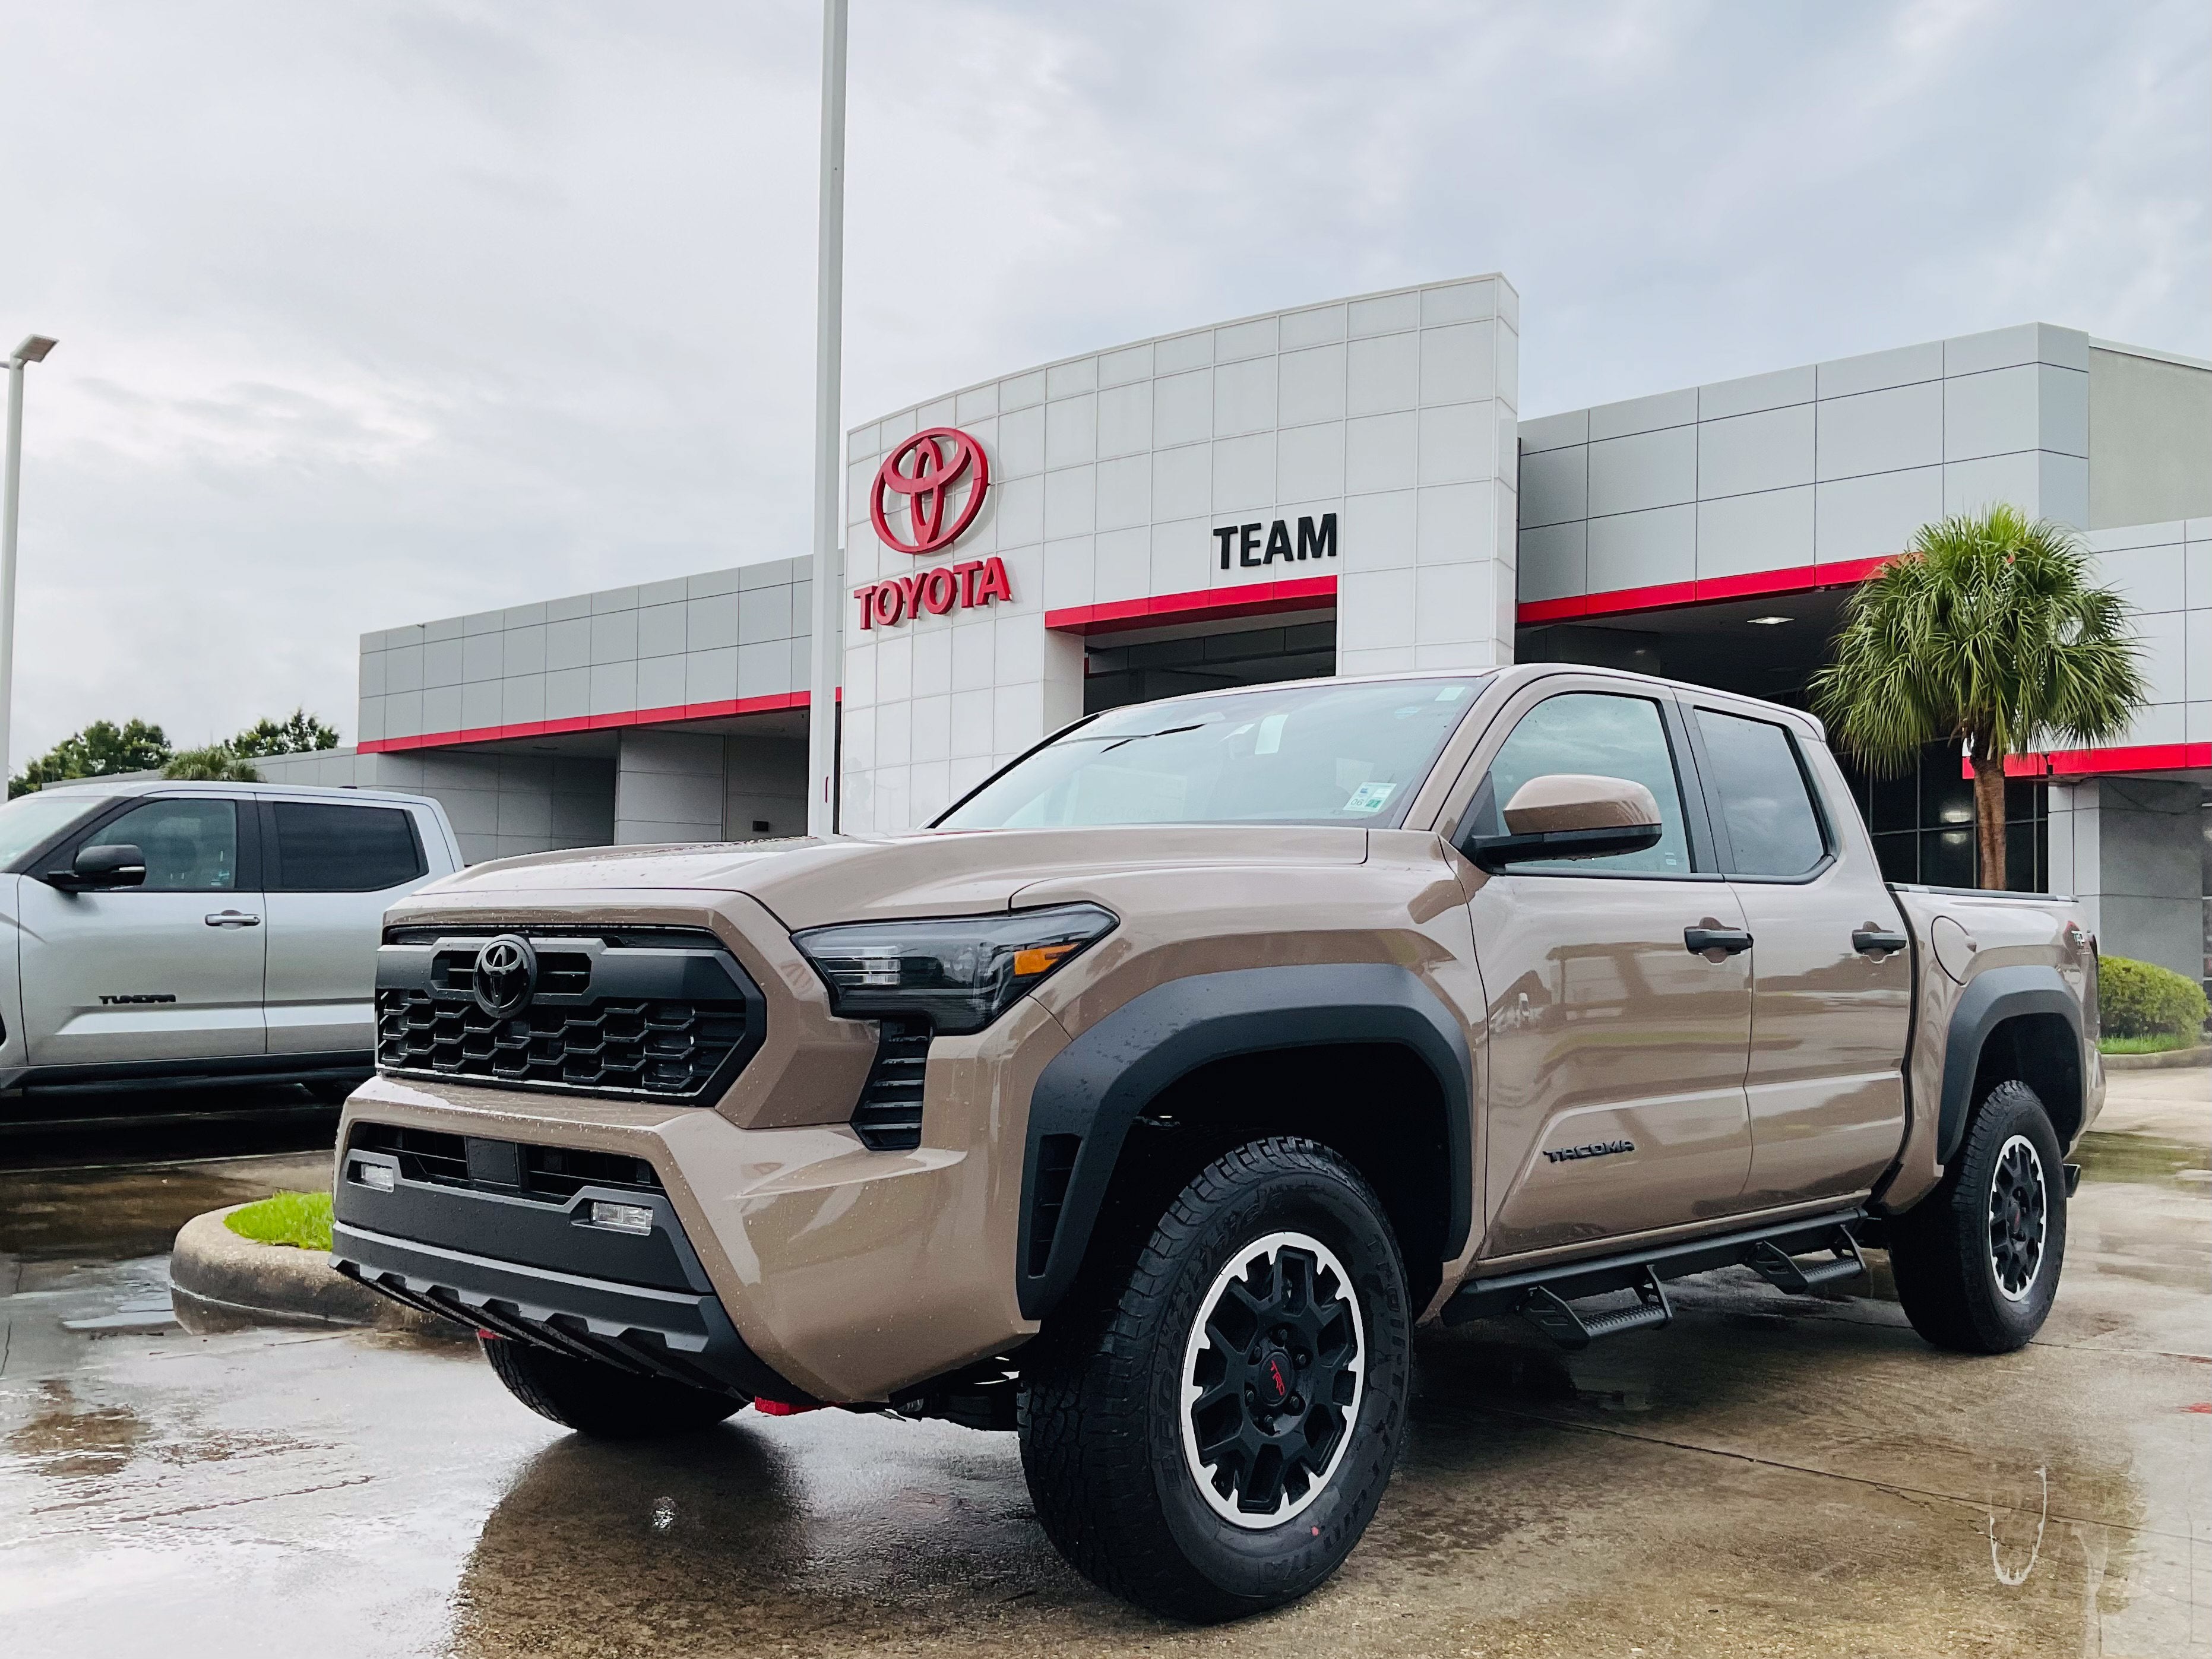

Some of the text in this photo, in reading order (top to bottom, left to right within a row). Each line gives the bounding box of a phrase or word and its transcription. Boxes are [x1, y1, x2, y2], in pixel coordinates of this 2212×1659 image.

[1213, 512, 1338, 569] TEAM
[853, 556, 1012, 631] TOYOTA
[99, 995, 176, 1005] TUNDRA
[1542, 1139, 1635, 1164] TACOMA
[1270, 1359, 1286, 1397] TRD
